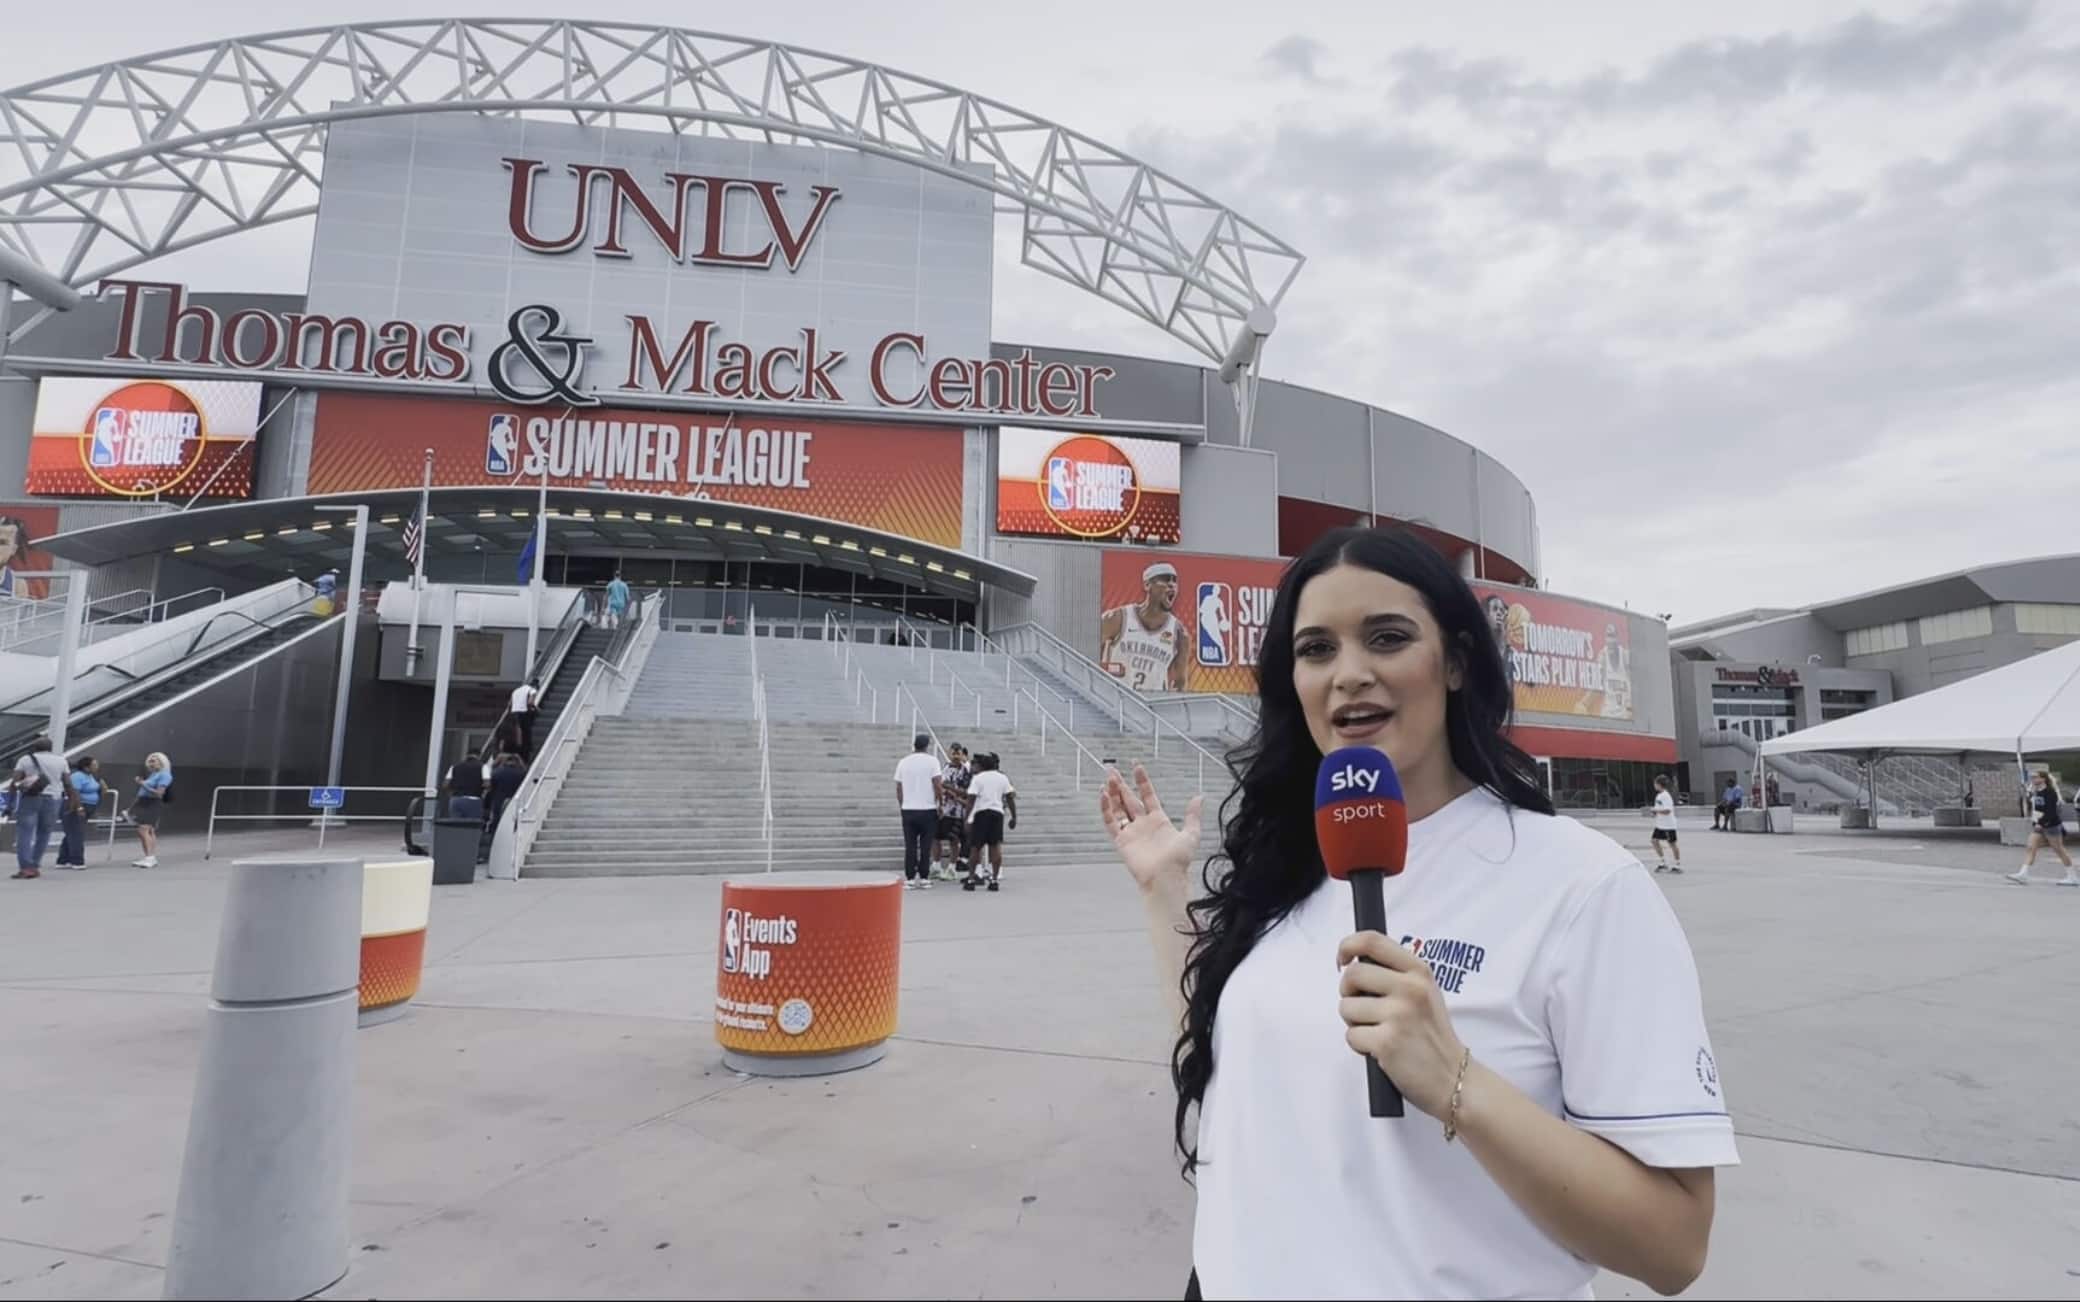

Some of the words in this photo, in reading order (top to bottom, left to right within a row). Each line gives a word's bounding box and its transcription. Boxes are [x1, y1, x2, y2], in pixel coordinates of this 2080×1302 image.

[502, 156, 840, 272] UNLV
[97, 279, 471, 382] Thomas
[488, 304, 600, 406] &
[619, 314, 848, 402] Mack
[869, 331, 1115, 418] Center
[128, 411, 199, 438] SUMMER
[124, 439, 184, 465] LEAGUE
[524, 417, 680, 482] SUMMER
[687, 427, 812, 488] LEAGUE
[1075, 462, 1133, 488] SUMMER
[1075, 487, 1125, 511] LEAGUE
[1512, 652, 1549, 684] STARS
[1552, 658, 1577, 687] PLAY
[1579, 662, 1604, 690] HERE
[1331, 764, 1380, 792] sky
[1333, 802, 1385, 824] sport
[743, 911, 798, 945] Events
[740, 943, 771, 980] App
[1418, 938, 1485, 973] SUMMER
